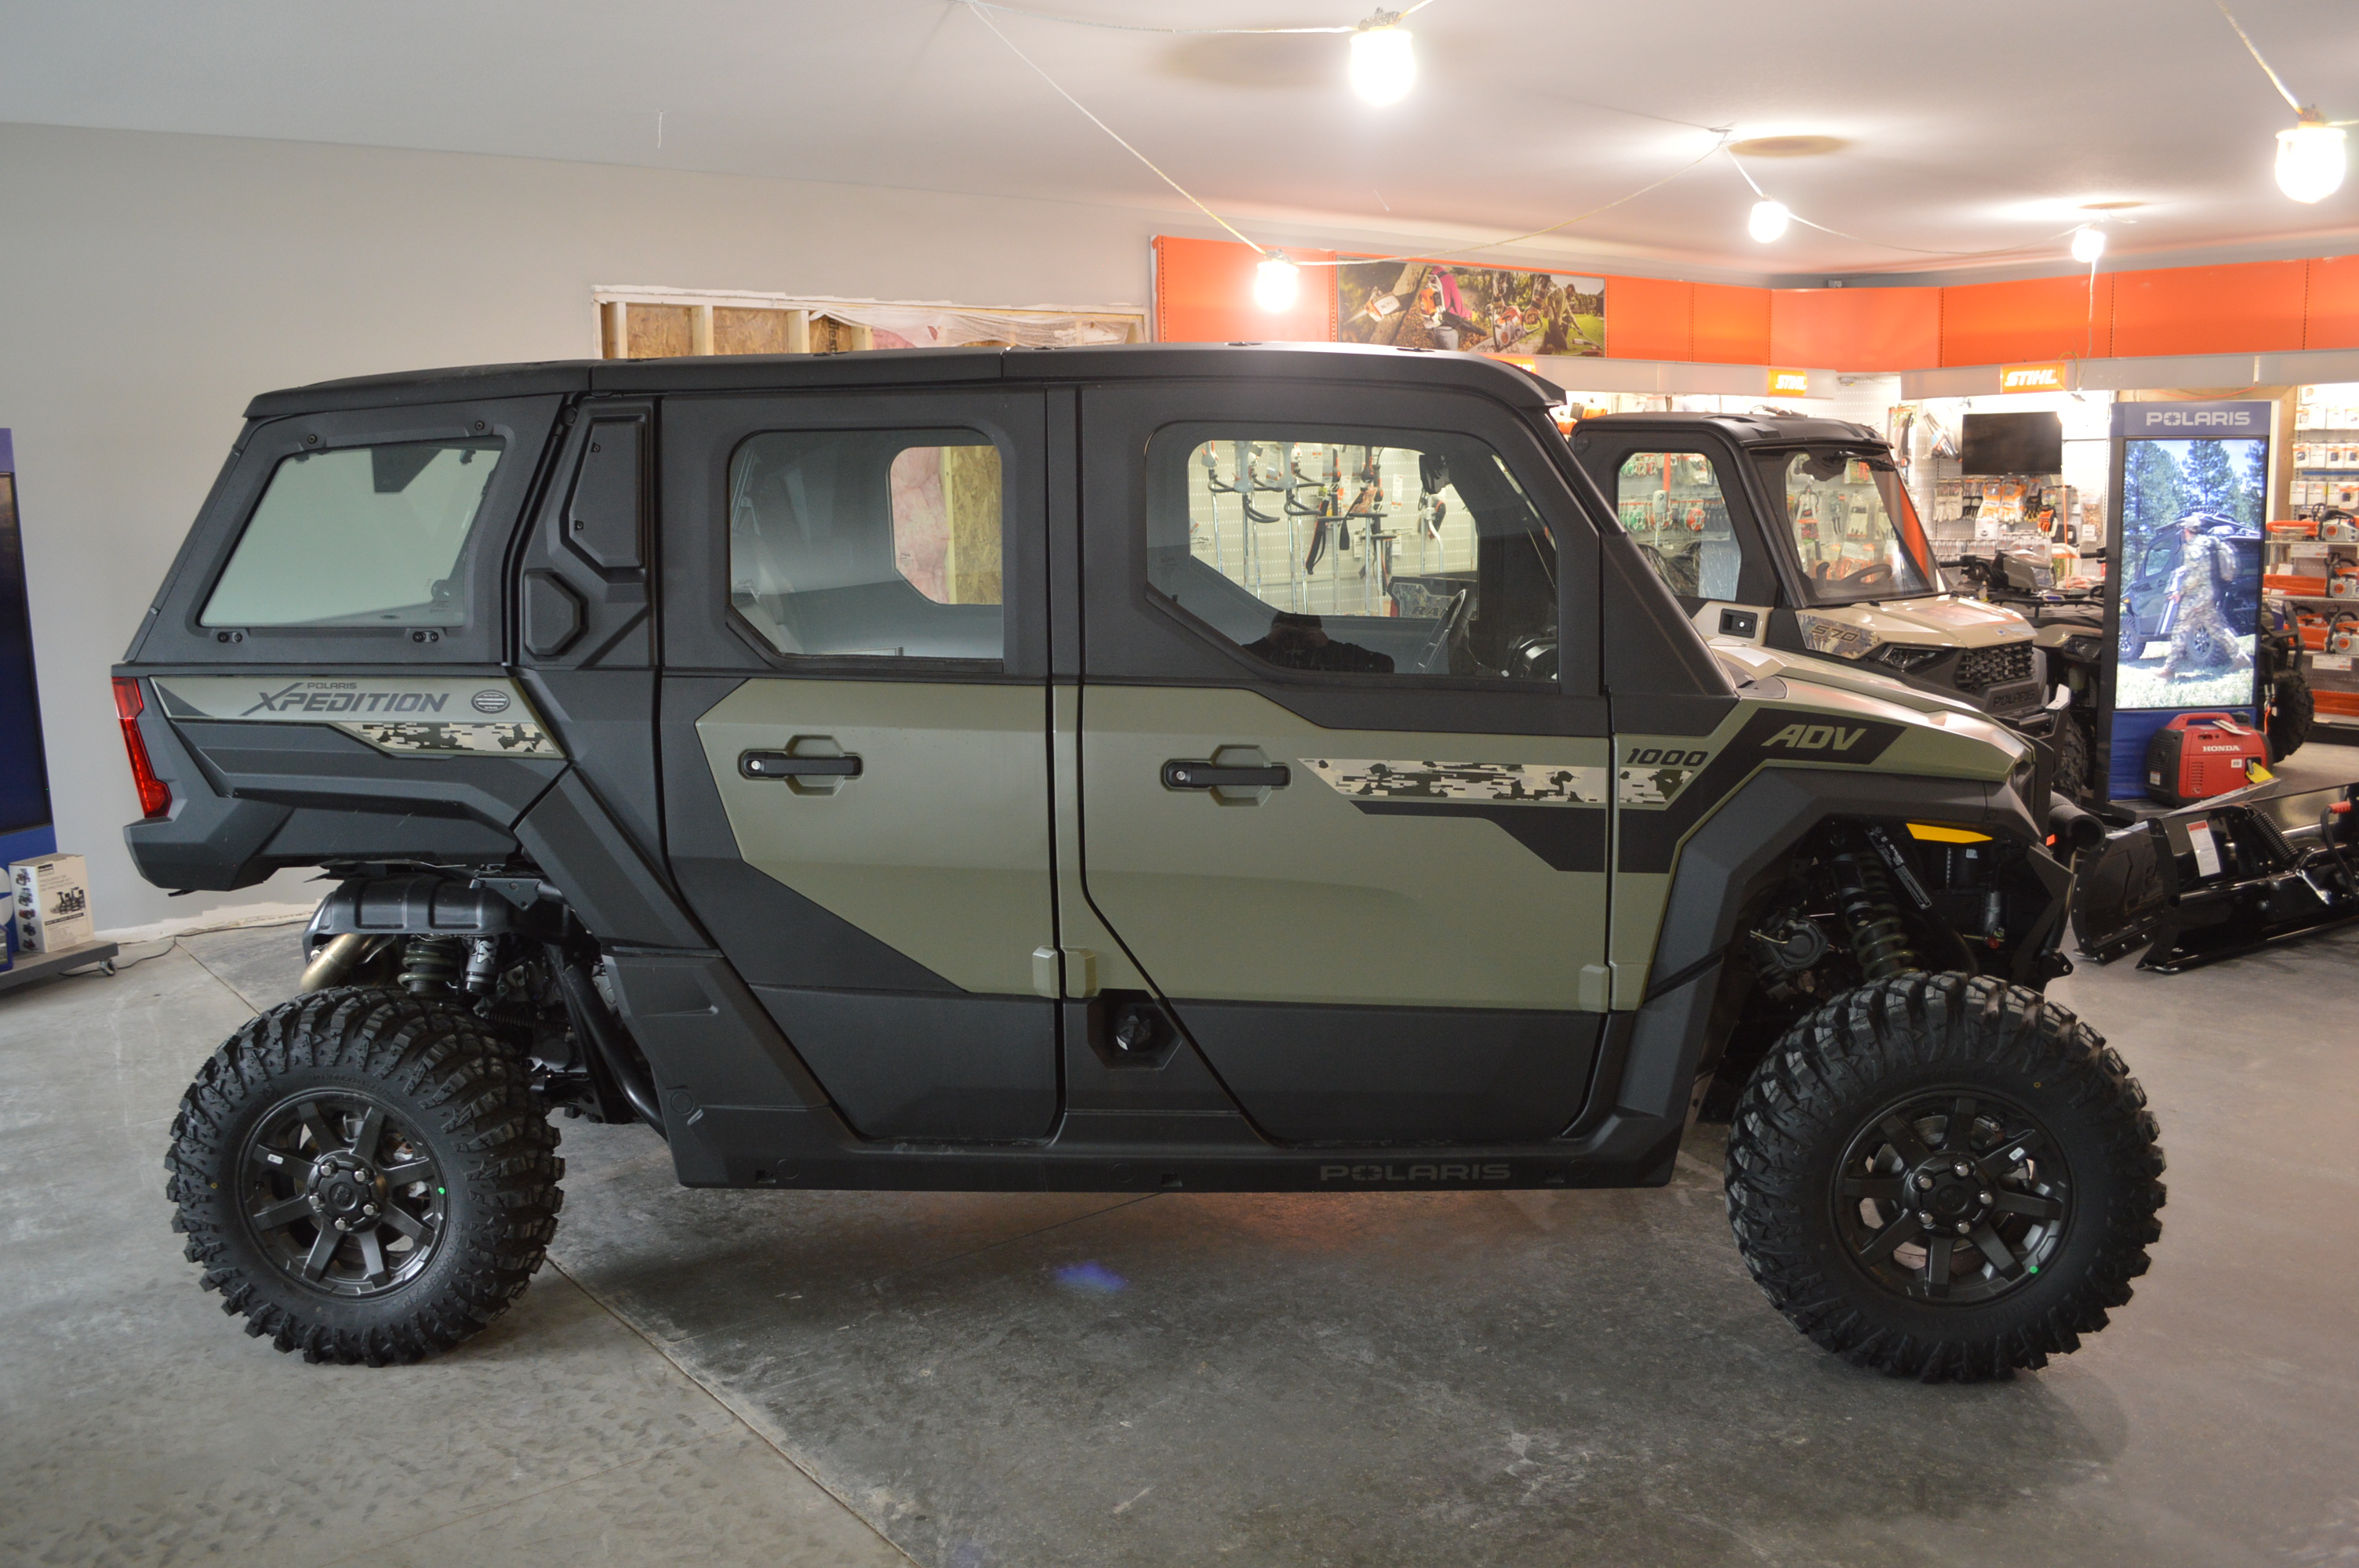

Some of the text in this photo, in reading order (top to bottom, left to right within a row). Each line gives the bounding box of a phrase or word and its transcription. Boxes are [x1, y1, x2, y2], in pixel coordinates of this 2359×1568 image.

[1776, 375, 1807, 390] STIHL
[2005, 369, 2057, 387] STIHL
[2146, 411, 2251, 426] POLARIS
[1810, 624, 1860, 643] 570
[238, 682, 450, 717] XPEDITION
[1993, 689, 2034, 707] POLARIS
[1760, 724, 1867, 750] ADV
[1625, 747, 1710, 767] 1000
[1320, 1163, 1511, 1182] POLARIS
